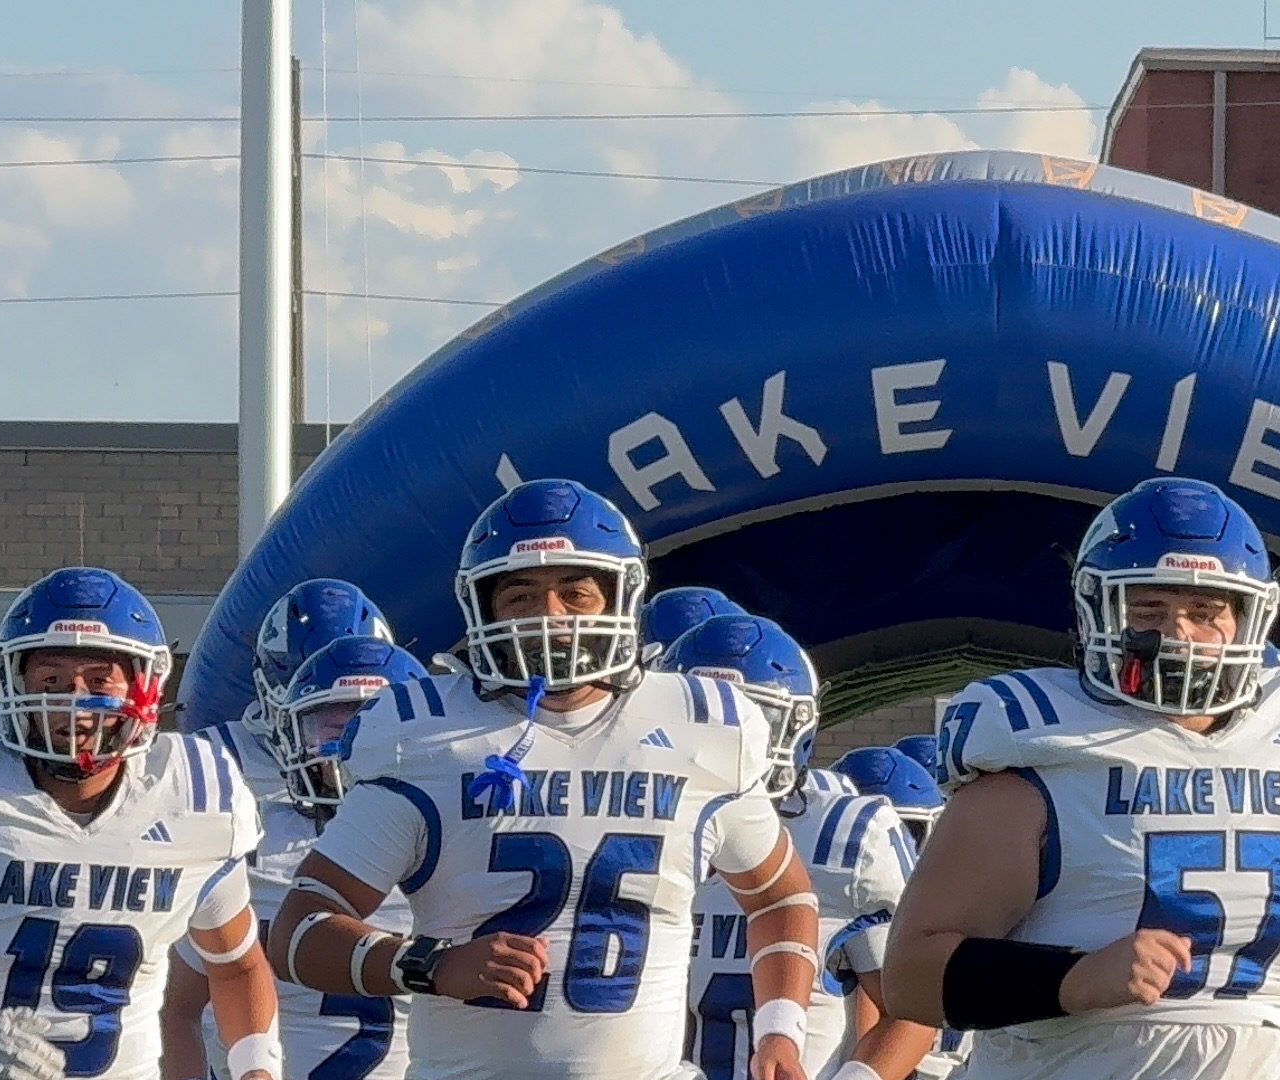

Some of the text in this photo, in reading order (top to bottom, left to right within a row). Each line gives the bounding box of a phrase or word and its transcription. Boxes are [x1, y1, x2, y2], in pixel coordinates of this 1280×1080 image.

[496, 358, 952, 512] AKE
[581, 770, 689, 822] VIEW
[1105, 766, 1216, 815] LAKE
[88, 863, 185, 912] VIEW
[463, 831, 666, 1014] 26
[1, 916, 144, 1078] 19
